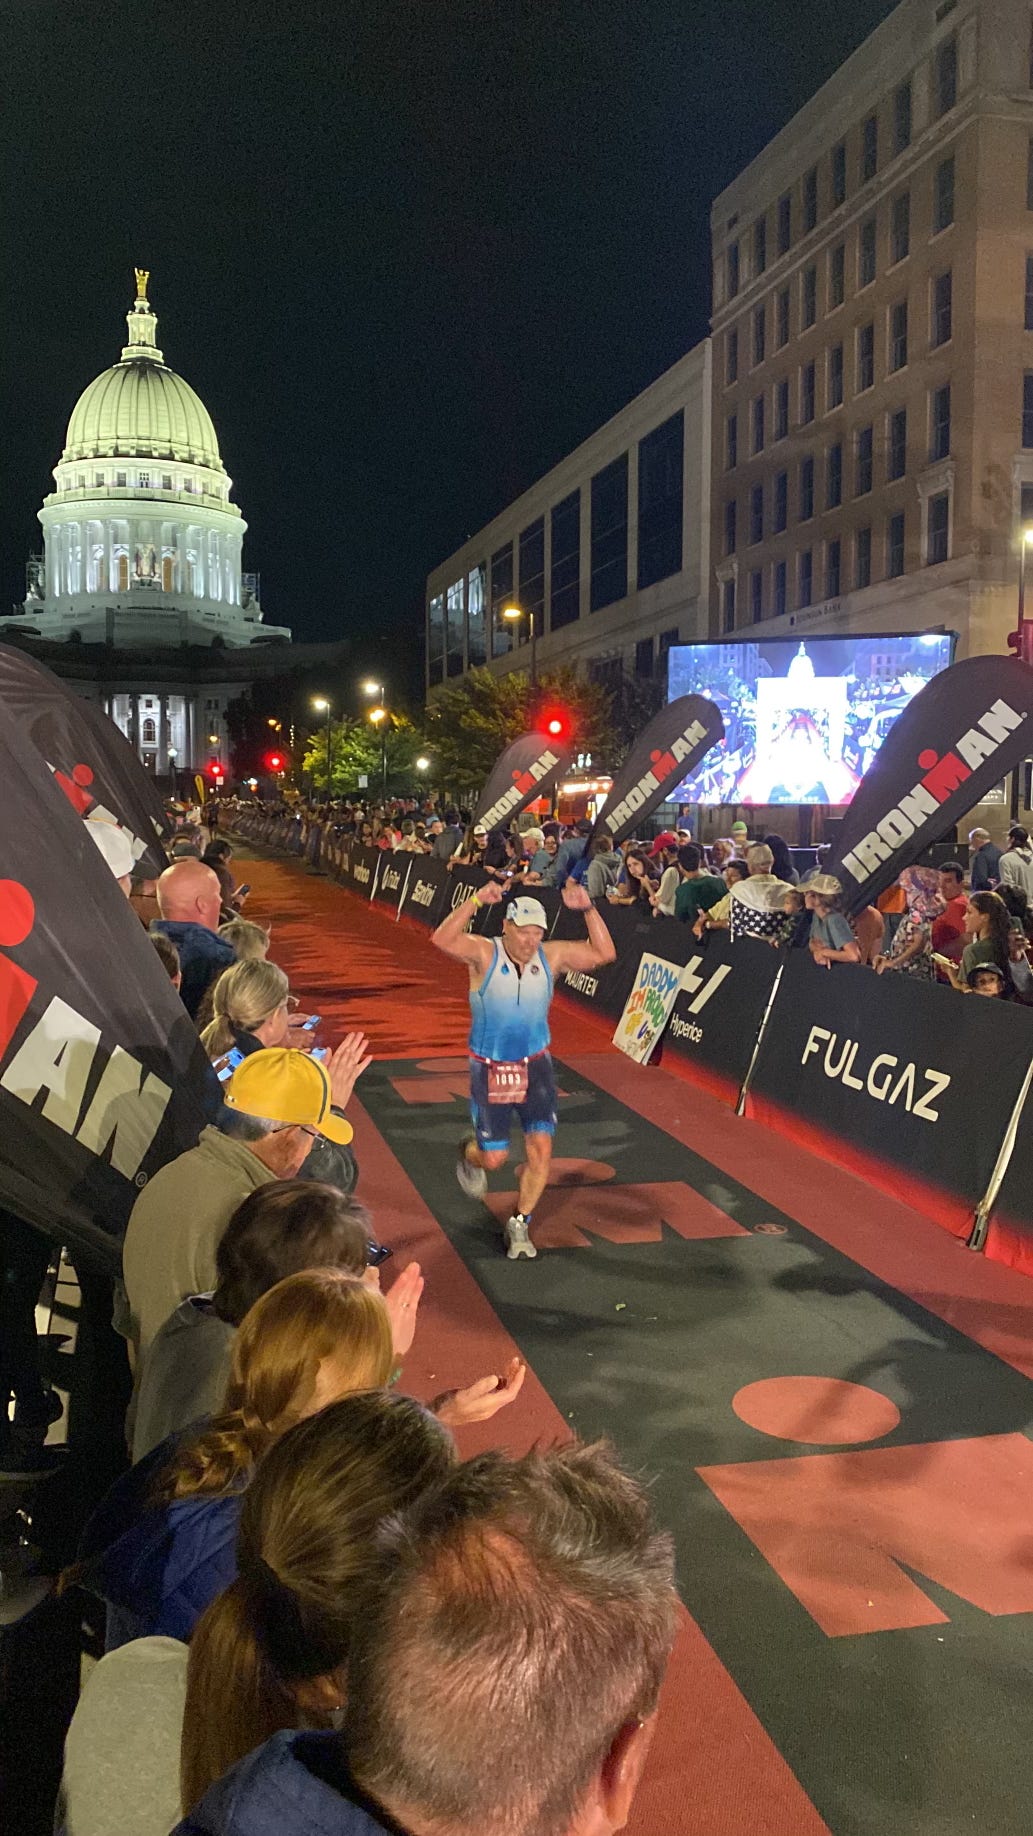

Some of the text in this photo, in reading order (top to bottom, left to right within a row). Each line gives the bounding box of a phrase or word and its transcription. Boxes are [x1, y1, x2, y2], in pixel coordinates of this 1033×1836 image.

[479, 750, 560, 831] IRONMAN
[605, 720, 708, 834] IRONMAN
[842, 699, 1023, 884] IRONMAN
[564, 970, 599, 998] MAURTEN
[639, 962, 678, 1000] DADDY
[670, 1012, 703, 1043] Hyperice
[801, 1025, 951, 1122] FULGAZ
